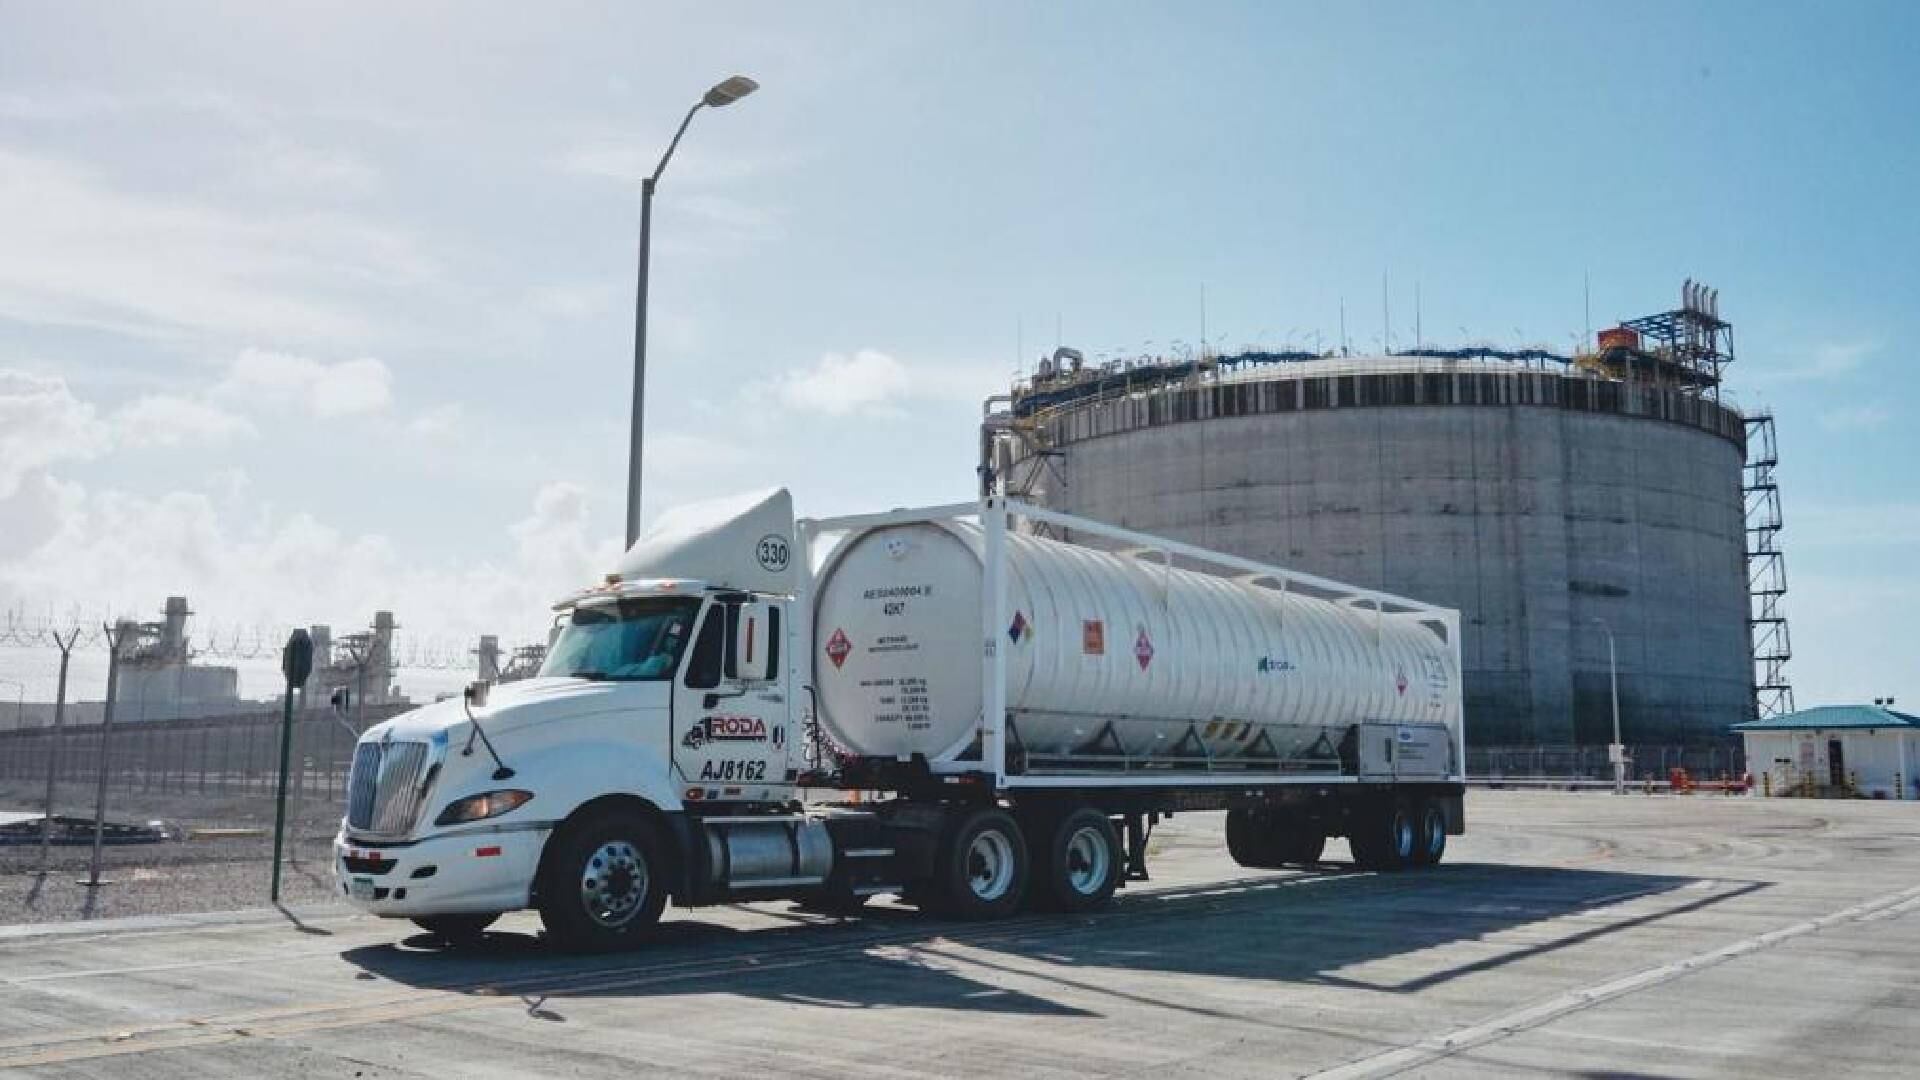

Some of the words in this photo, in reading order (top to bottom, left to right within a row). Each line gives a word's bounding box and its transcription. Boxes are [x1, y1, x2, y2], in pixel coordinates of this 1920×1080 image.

[761, 543, 787, 564] 330
[711, 718, 766, 734] RODA
[701, 760, 766, 781] AJ8162
